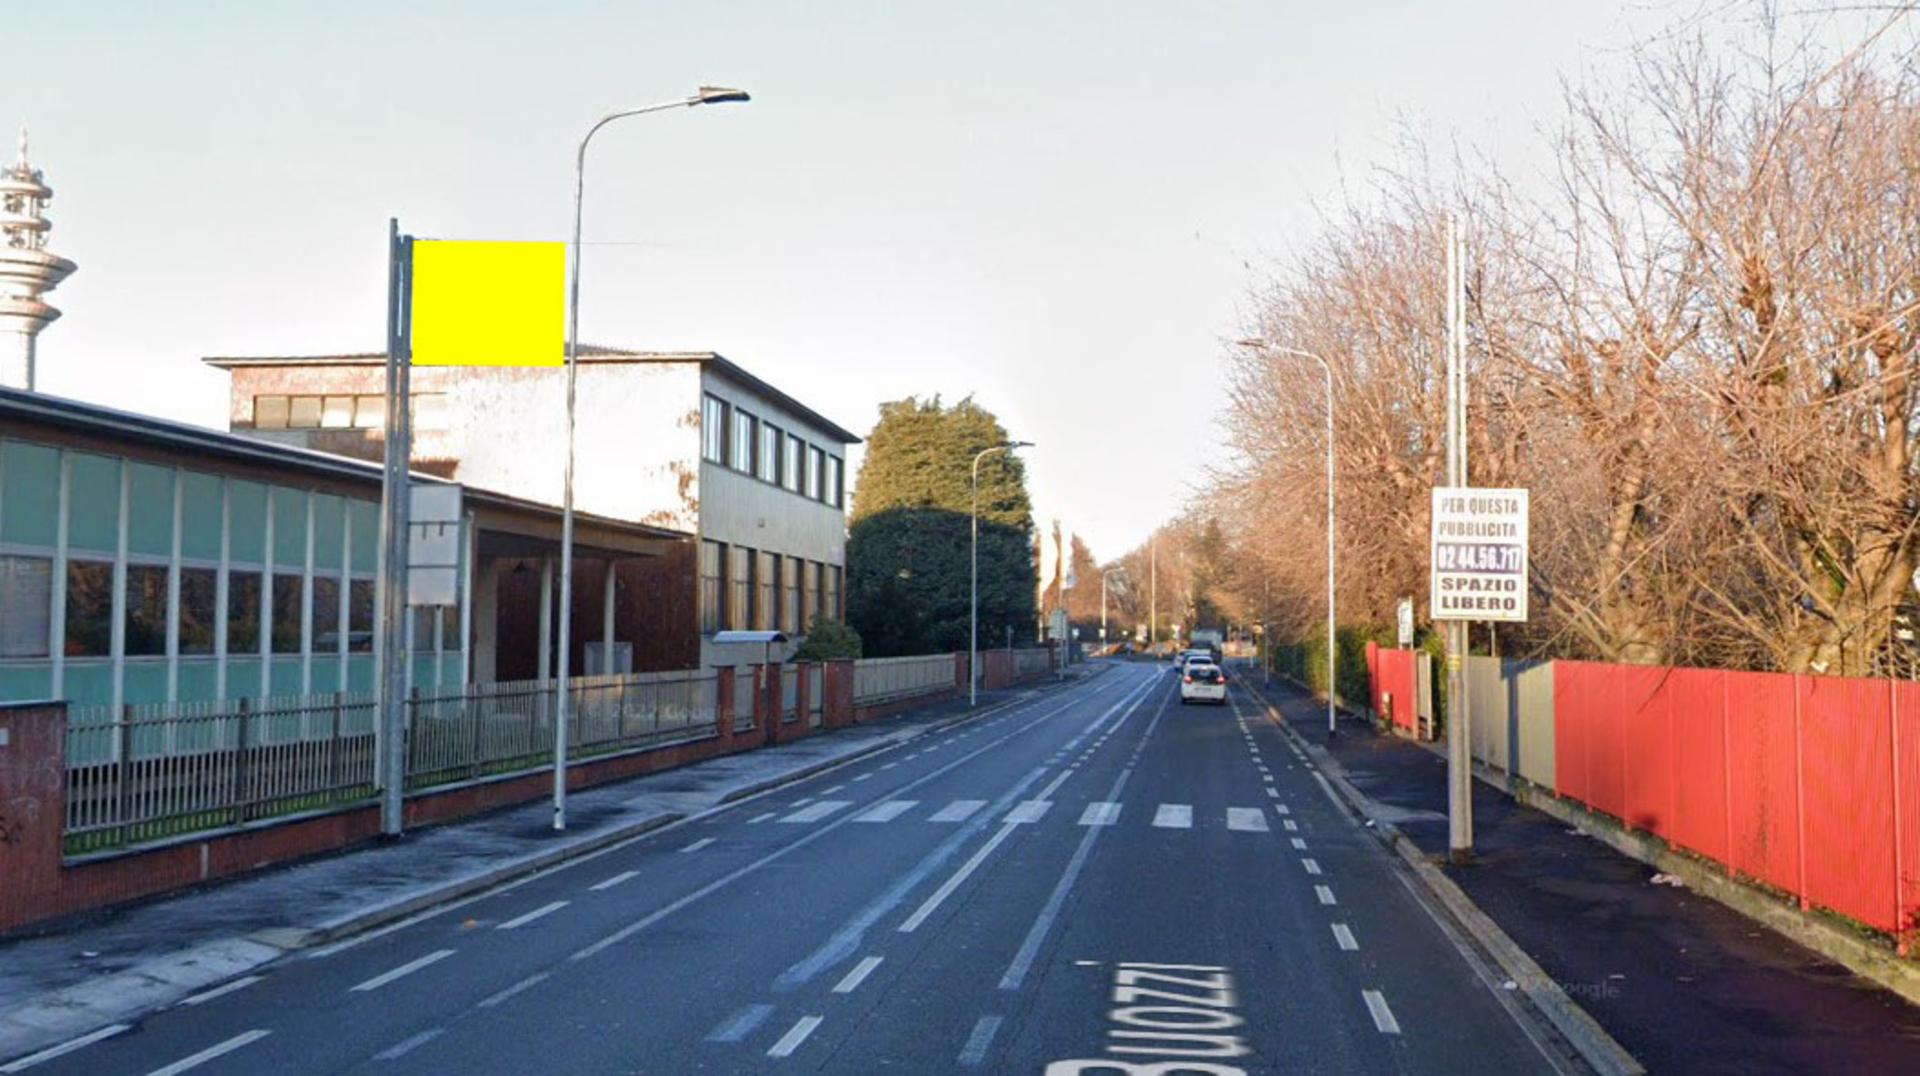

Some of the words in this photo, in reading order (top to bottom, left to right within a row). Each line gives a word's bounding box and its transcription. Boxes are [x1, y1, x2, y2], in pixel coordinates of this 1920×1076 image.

[1442, 497, 1465, 514] PER
[1468, 498, 1519, 515] QUESTA
[1438, 545, 1456, 570] 02
[1441, 577, 1518, 592] SPAZIO
[1441, 596, 1517, 610] LIBERO
